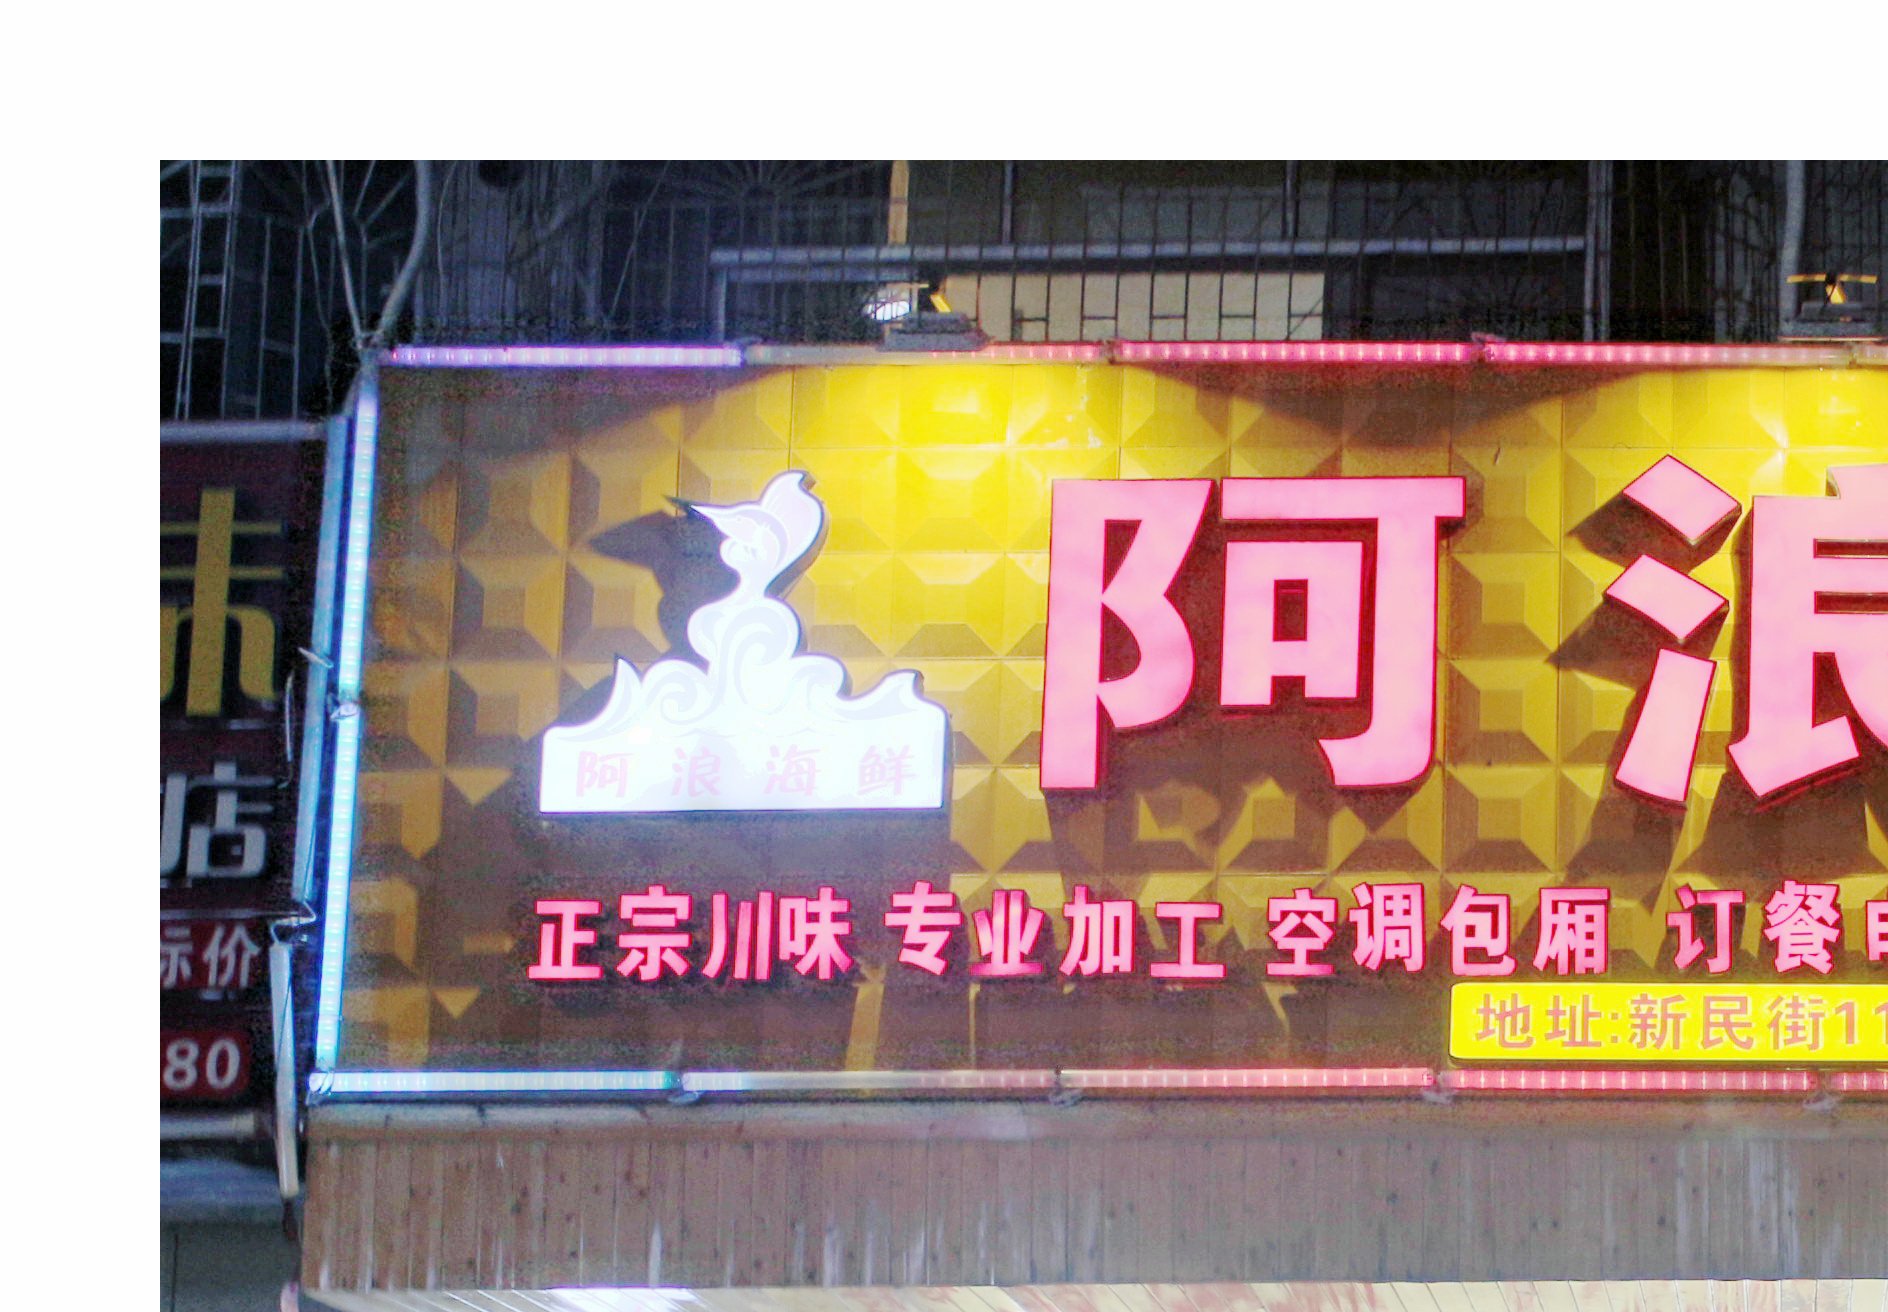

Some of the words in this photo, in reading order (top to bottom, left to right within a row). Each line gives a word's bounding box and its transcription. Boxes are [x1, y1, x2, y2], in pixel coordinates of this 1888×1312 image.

[576, 745, 917, 799] 阿浪海鲜
[527, 884, 853, 981] 正宗川味
[885, 881, 1228, 979] 专业加工
[1266, 881, 1610, 979] 空调包厢
